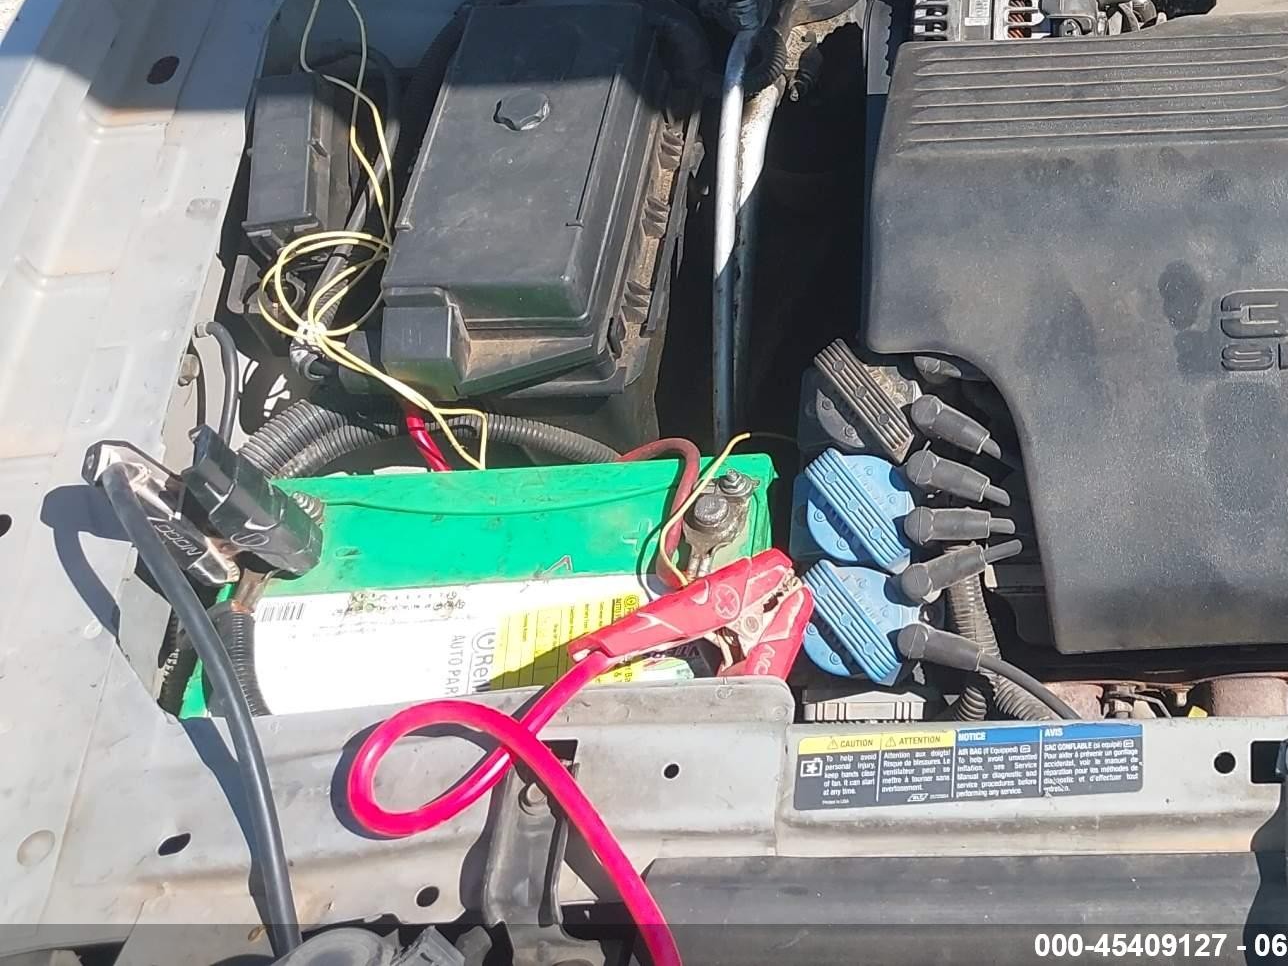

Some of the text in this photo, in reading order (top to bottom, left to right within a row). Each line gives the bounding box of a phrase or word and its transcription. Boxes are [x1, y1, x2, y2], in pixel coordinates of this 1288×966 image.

[444, 635, 466, 695] AUTO PAR
[958, 732, 986, 741] NOTICE
[1045, 728, 1063, 737] AVIS
[840, 740, 873, 748] CAUTION
[899, 736, 940, 745] ATTENTION
